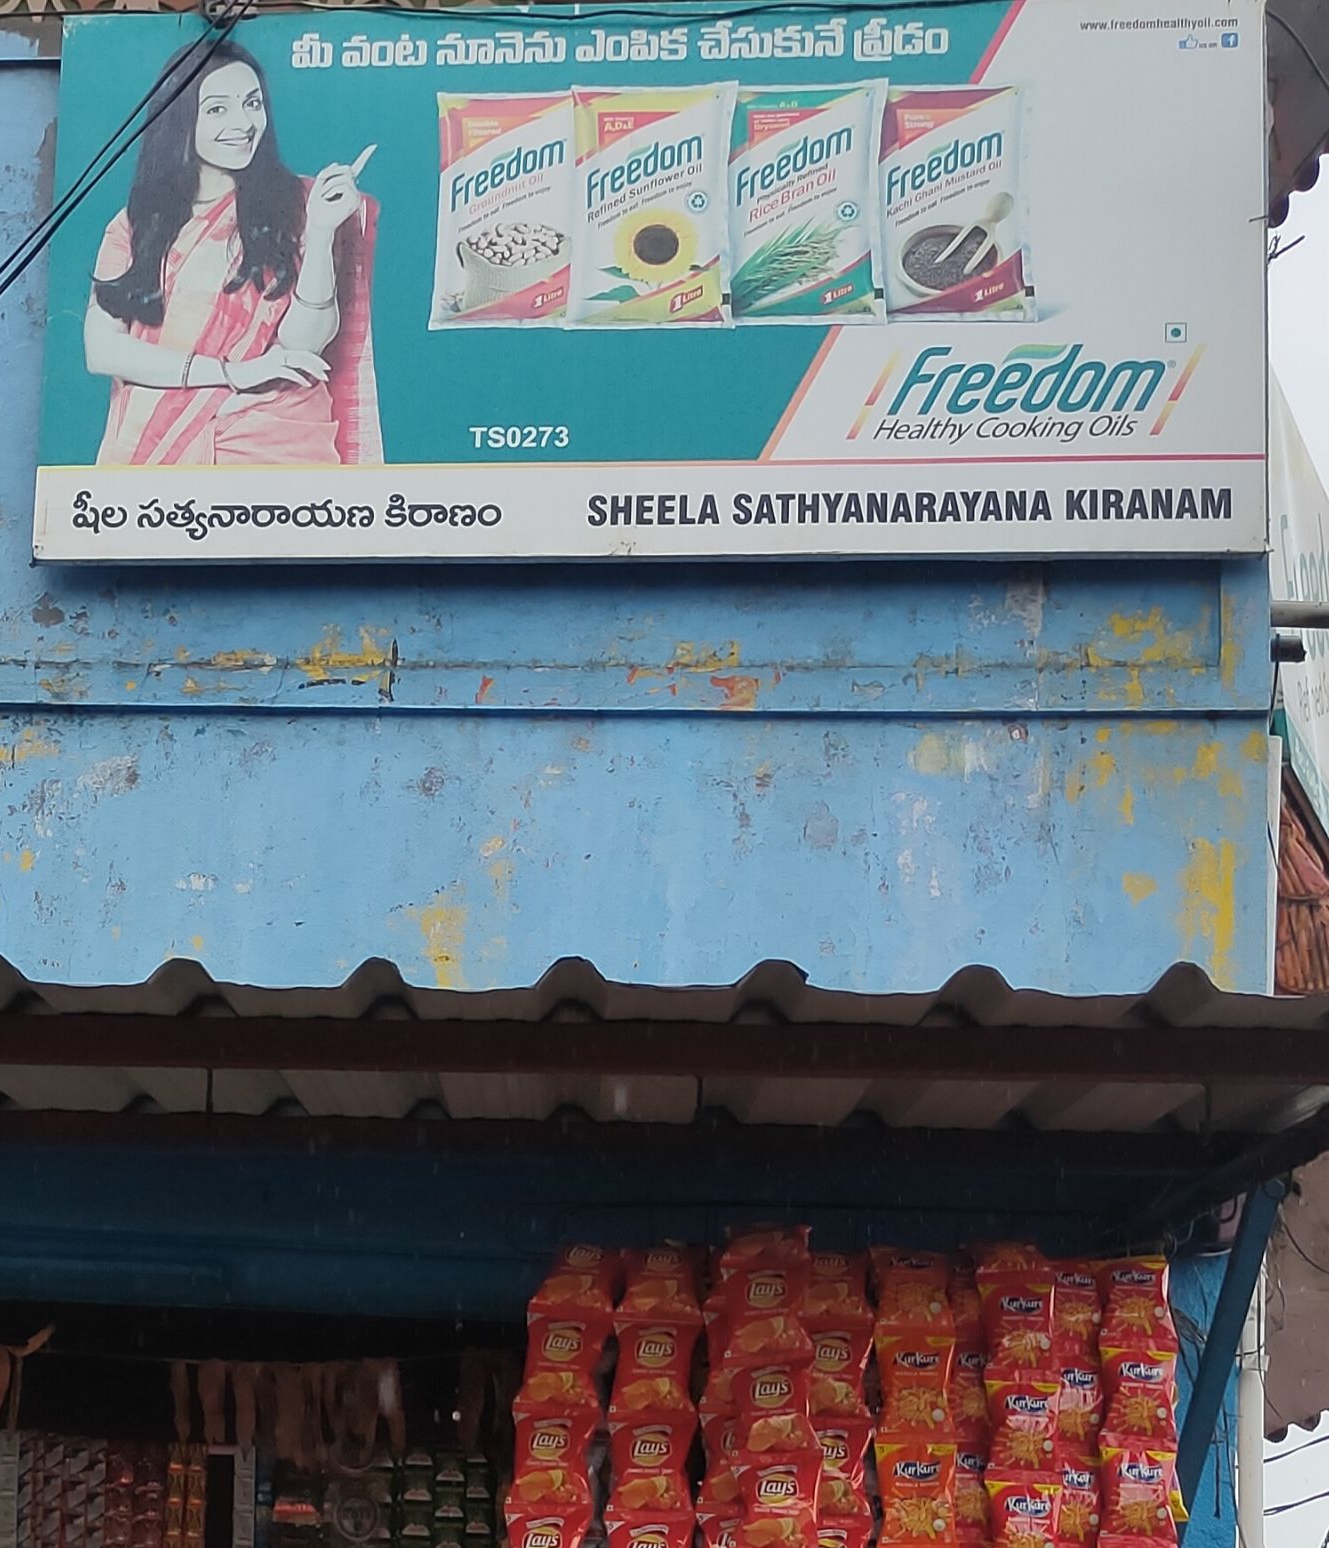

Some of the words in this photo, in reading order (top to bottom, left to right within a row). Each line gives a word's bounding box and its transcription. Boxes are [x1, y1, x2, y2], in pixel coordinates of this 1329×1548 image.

[1080, 17, 1238, 30] www.freedomhealthyoil.com
[292, 33, 332, 68] మీ
[341, 33, 427, 66] వంట
[575, 29, 688, 61] ఎంపిక
[451, 140, 564, 212] Freedom
[587, 136, 702, 209] Freedom
[736, 127, 852, 207] Freedom
[887, 132, 1002, 206] Freedom
[588, 193, 626, 224] Refined
[630, 170, 685, 199] Sunflower
[687, 164, 702, 177] Oil
[749, 198, 778, 223] Rice
[781, 182, 814, 206] Bran
[819, 169, 836, 189] Oil
[886, 197, 913, 219] Kachi
[915, 182, 943, 202] Ghani
[945, 167, 986, 188] Mustard
[543, 288, 564, 303] Litre
[683, 287, 702, 302] Litre
[833, 286, 852, 299] Litre
[984, 282, 1004, 297] Litre
[886, 344, 1166, 416] Freedom
[469, 426, 570, 448] TS0273
[873, 418, 973, 445] Healthy
[976, 415, 1072, 443] Cooking
[1088, 414, 1138, 439] Oils
[72, 491, 127, 533] షీల
[137, 498, 373, 541] సత్యనారాయణ
[384, 493, 502, 530] కిరాణం
[587, 493, 720, 527] SHEELA
[732, 488, 1053, 525] SATHYANARAYANA
[1064, 487, 1233, 520] KIRANAM
